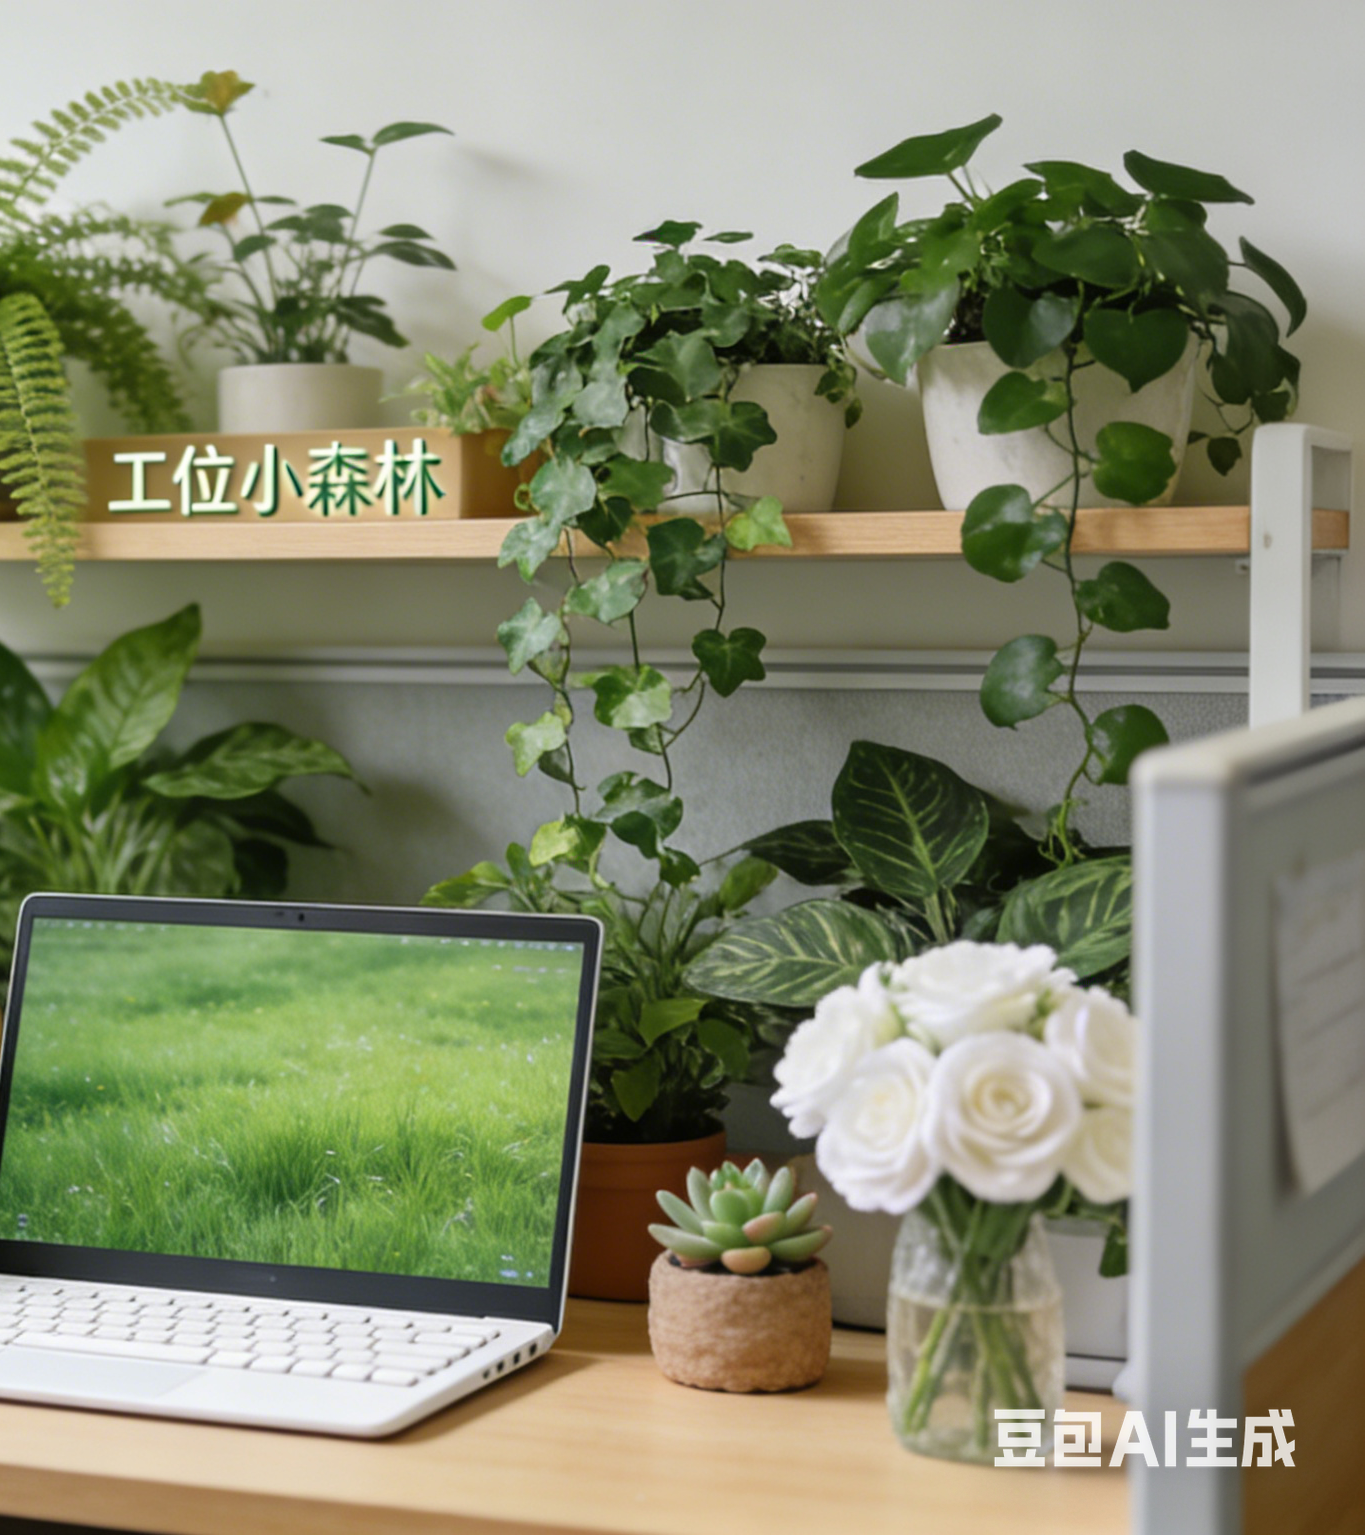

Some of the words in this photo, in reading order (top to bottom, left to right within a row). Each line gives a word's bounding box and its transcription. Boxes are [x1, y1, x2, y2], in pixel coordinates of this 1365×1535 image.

[108, 437, 446, 517] 工位小森林
